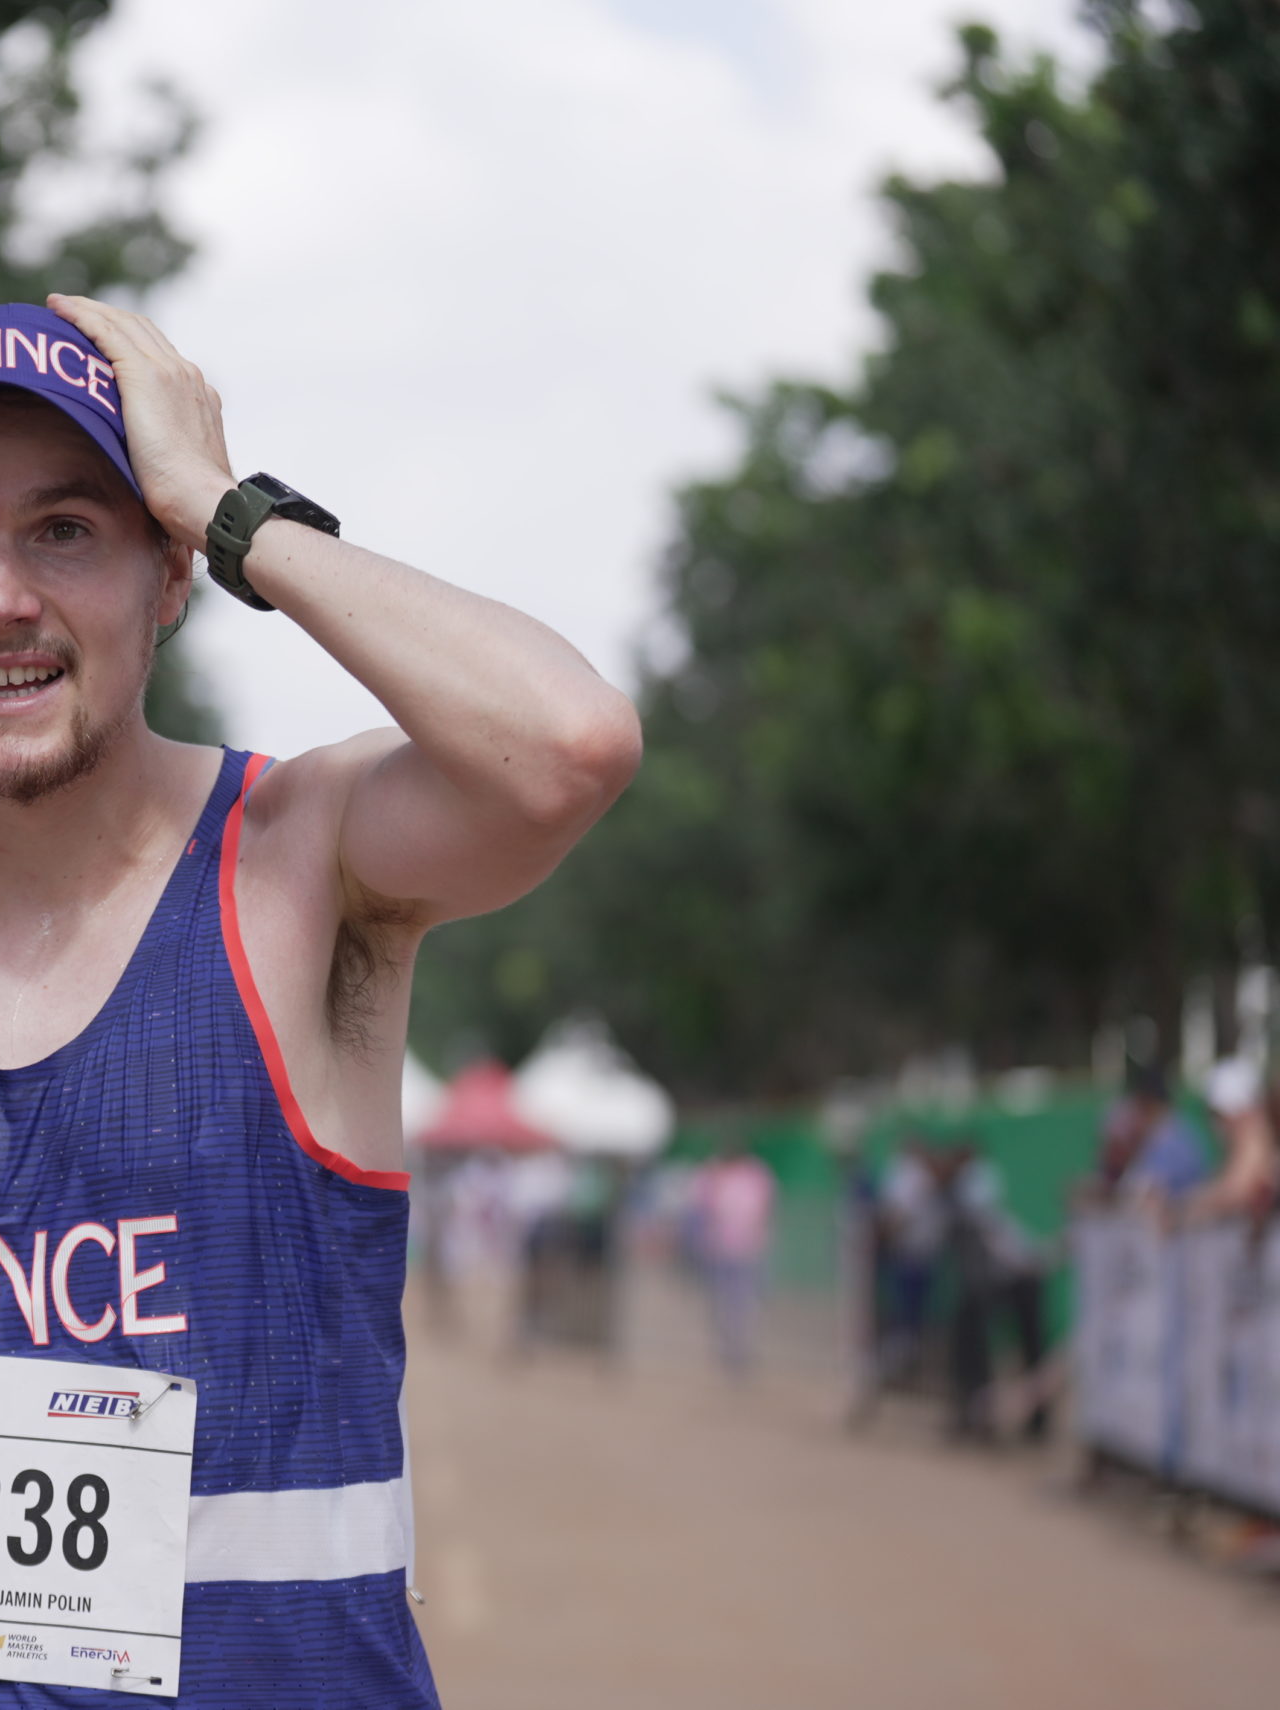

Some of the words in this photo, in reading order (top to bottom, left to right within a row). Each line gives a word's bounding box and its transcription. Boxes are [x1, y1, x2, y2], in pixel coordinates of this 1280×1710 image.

[53, 1393, 132, 1416] NEB
[48, 1594, 91, 1612] POLIN
[8, 1634, 37, 1643] WORLD
[7, 1642, 44, 1652] MASTERS
[6, 1650, 48, 1660] ATHLETICS
